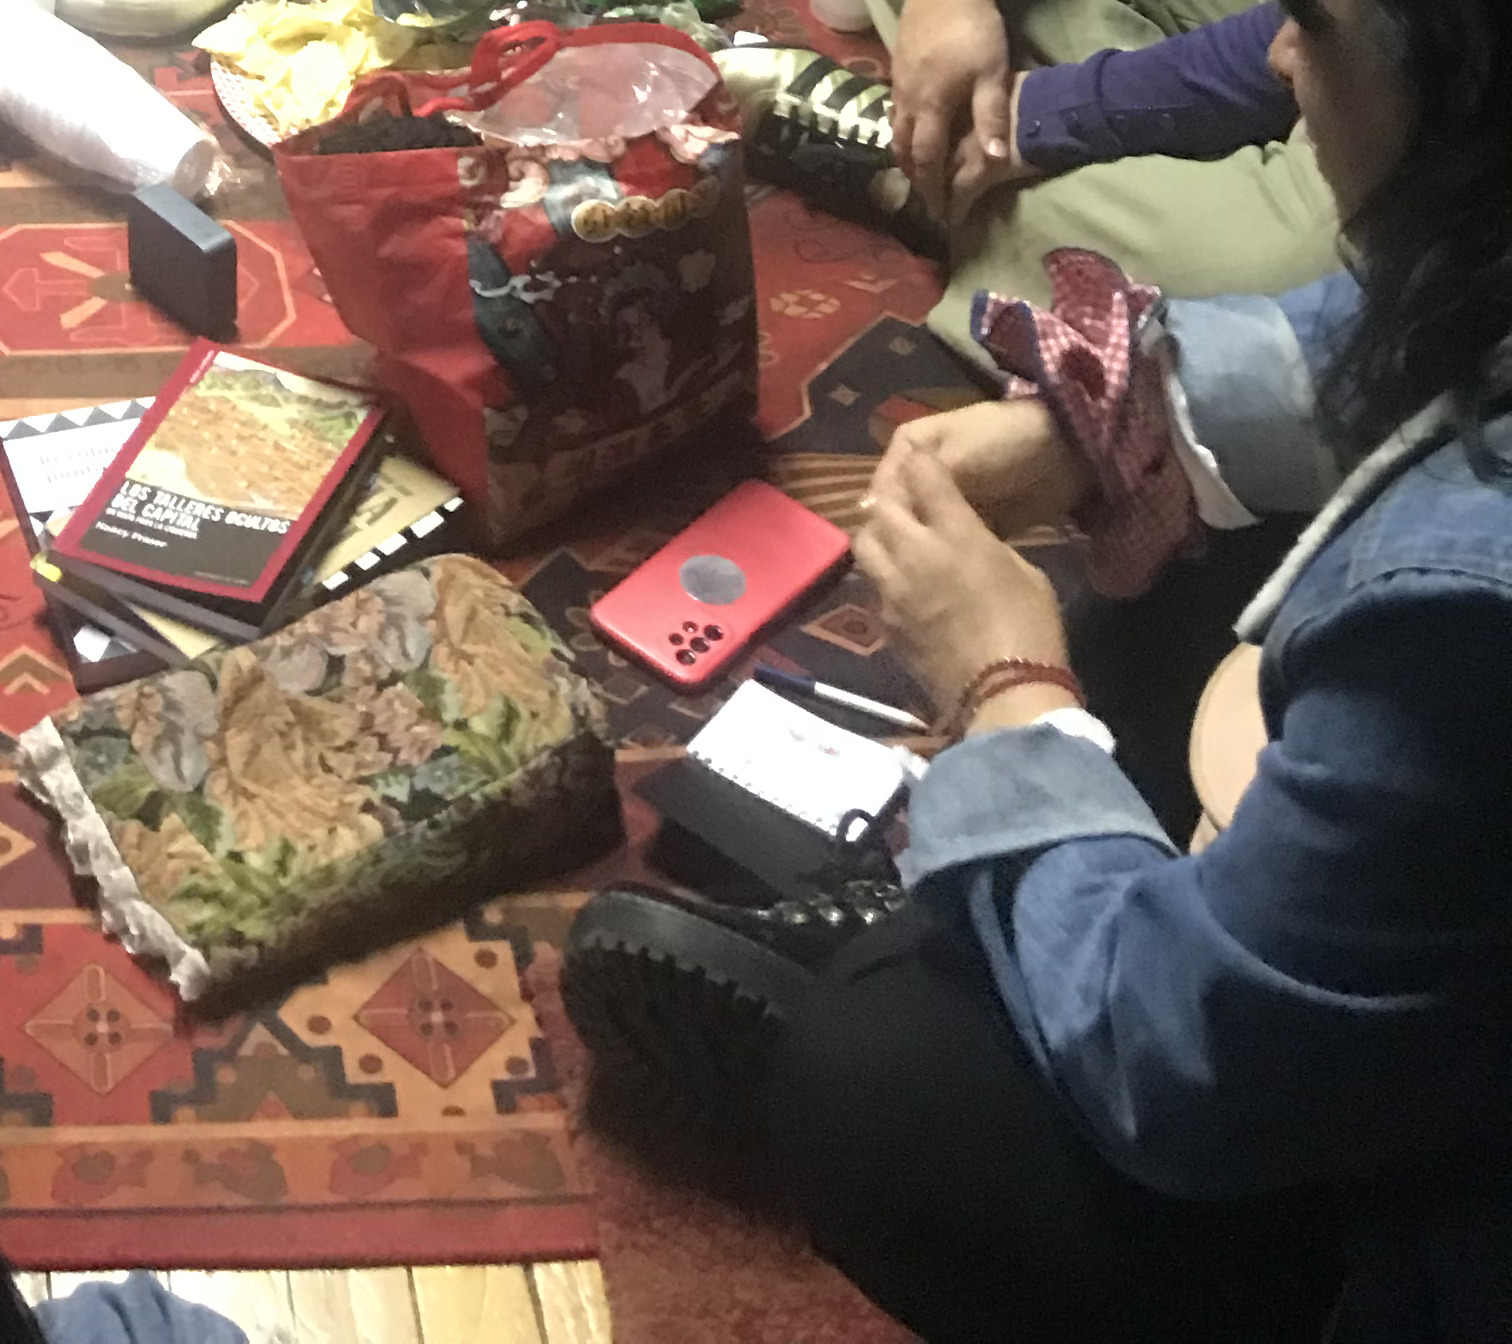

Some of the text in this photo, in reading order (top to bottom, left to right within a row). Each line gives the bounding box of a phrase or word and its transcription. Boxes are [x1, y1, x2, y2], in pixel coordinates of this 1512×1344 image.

[110, 493, 139, 513] DEL
[141, 503, 201, 531] CAPITAL
[119, 480, 152, 501] LOS
[153, 490, 225, 522] TALLERES
[224, 511, 291, 535] OCULTOS
